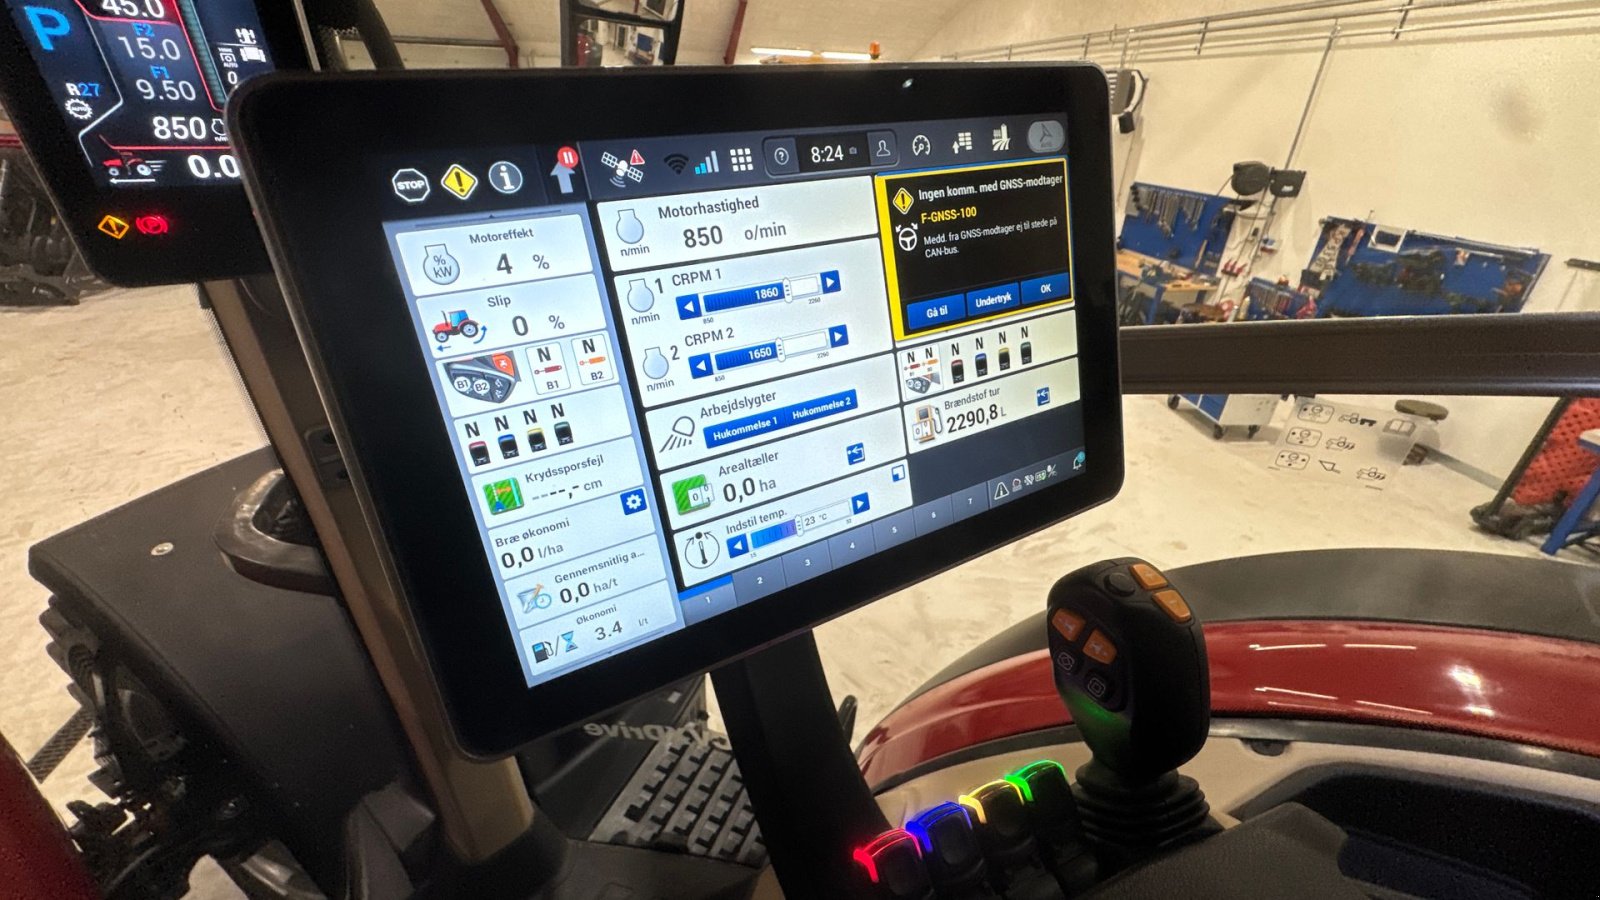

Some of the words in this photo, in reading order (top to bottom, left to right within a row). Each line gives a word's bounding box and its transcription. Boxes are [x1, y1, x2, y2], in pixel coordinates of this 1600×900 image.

[102, 0, 165, 18] 45.0
[24, 6, 70, 51] P
[132, 23, 155, 37] F2
[118, 36, 181, 60] 15.0
[150, 65, 171, 79] F1
[135, 79, 197, 101] 9.50
[153, 116, 207, 140] 850
[810, 144, 844, 163] 8:24
[187, 155, 240, 180] 0.0
[397, 180, 425, 190] STOP
[918, 188, 945, 202] Ingen
[947, 184, 978, 198] komm.
[980, 181, 998, 193] med
[1000, 174, 1063, 191] GNSS-modtager
[658, 196, 760, 219] Motorhastighed
[920, 206, 977, 224] F-GNSS-100
[469, 228, 534, 244] Motoreffekt
[683, 225, 723, 249] 850
[744, 222, 787, 241] o/min
[924, 233, 947, 246] Medd.
[949, 232, 959, 242] fra
[960, 225, 1015, 241] GNSS-modtager
[1016, 222, 1023, 232] ej
[1031, 218, 1048, 228] stede
[1050, 216, 1058, 228] på
[620, 244, 650, 257] n/min
[925, 246, 960, 258] CAN-bus.
[434, 266, 452, 278] kW
[496, 253, 513, 275] 4
[532, 254, 550, 270] %
[672, 269, 713, 287] CRPM
[714, 268, 722, 281] 1
[755, 287, 779, 300] 1860
[1040, 284, 1052, 293] OK
[487, 296, 511, 308] Slip
[976, 292, 1012, 308] Undertryk
[631, 312, 660, 326] n/min
[926, 306, 938, 318] Gå
[939, 304, 948, 316] til
[512, 315, 529, 337] 0
[548, 314, 565, 330] %
[1020, 326, 1028, 338] N
[582, 338, 596, 354] N
[684, 329, 725, 348] CRPM
[726, 327, 735, 340] 2
[976, 337, 984, 350] N
[999, 331, 1006, 344] N
[537, 346, 552, 363] N
[748, 347, 772, 361] 1650
[908, 351, 916, 364] N
[925, 346, 933, 358] N
[951, 342, 960, 356] N
[457, 380, 469, 389] B1
[547, 380, 560, 390] B1
[591, 371, 604, 382] B2
[646, 378, 674, 392] n/min
[475, 382, 488, 392] B2
[700, 391, 777, 419] Arbejdslygter
[944, 389, 986, 410] Brændstof
[988, 388, 1000, 399] tur
[523, 408, 538, 425] N
[551, 402, 565, 418] N
[792, 400, 844, 420] Hukommelse
[844, 396, 852, 406] 2
[494, 415, 510, 432] N
[946, 403, 999, 434] 2290,8
[464, 421, 480, 438] N
[713, 418, 772, 441] Hukommelse
[525, 455, 604, 483] Krydssporsfejl
[718, 450, 779, 477] Arealtæller
[583, 479, 603, 492] cm
[722, 477, 756, 504] 0,0
[759, 478, 777, 492] ha
[726, 519, 758, 534] Indstil
[759, 508, 788, 524] temp.
[804, 516, 816, 527] 23
[495, 533, 520, 548] Bræ
[522, 518, 570, 540] økonomi
[501, 546, 535, 569] 0,0
[538, 543, 564, 558] l/ha
[554, 554, 629, 584] Gennemsnitlig
[559, 582, 590, 604] 0,0
[593, 579, 619, 594] ha/t
[576, 604, 618, 626] Økonomi
[594, 620, 624, 641] 3.4
